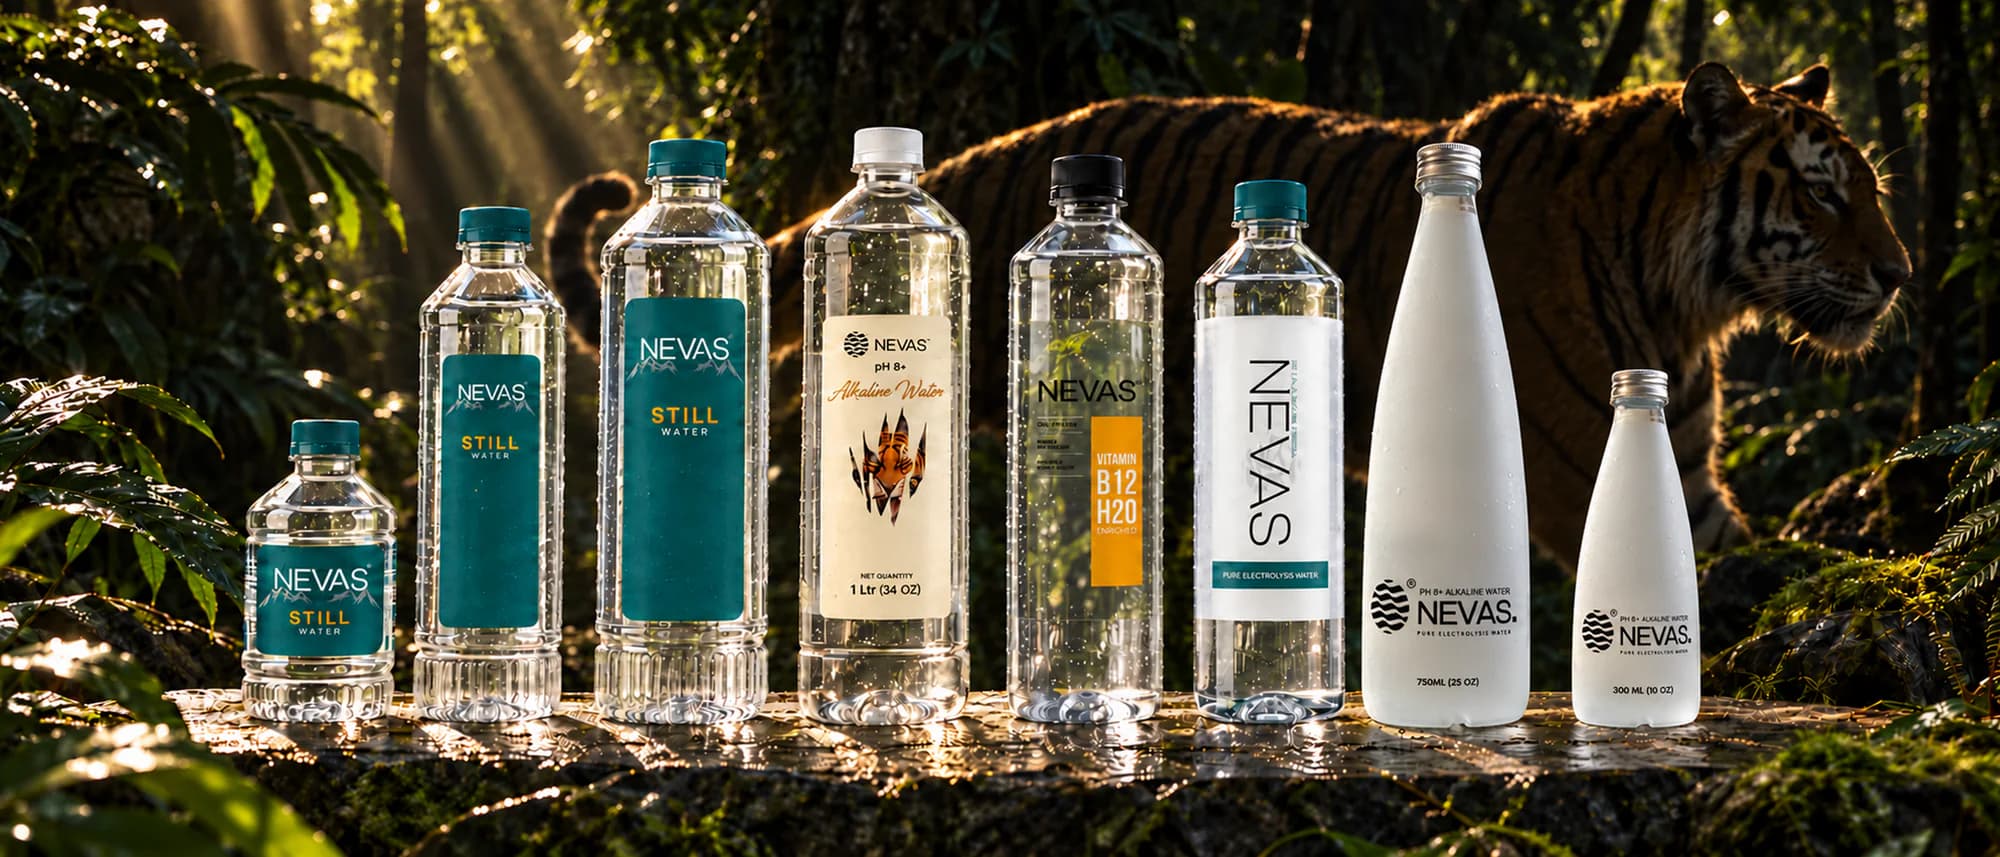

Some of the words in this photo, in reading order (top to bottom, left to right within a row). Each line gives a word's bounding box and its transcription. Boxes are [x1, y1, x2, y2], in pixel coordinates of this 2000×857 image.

[640, 337, 730, 360] NEVAS
[874, 338, 928, 351] NEVAS
[874, 362, 890, 373] pH
[893, 362, 906, 371] 8+
[458, 383, 526, 401] NEVAS
[827, 380, 893, 401] Alkaline
[894, 379, 945, 400] Water
[1037, 379, 1136, 402] NEVAS
[651, 406, 719, 424] STILL
[661, 427, 709, 436] WATER
[461, 435, 519, 451] STILL
[1097, 453, 1137, 465] VITAMIN
[1249, 360, 1291, 546] NEVAS
[1097, 469, 1137, 495] B12
[273, 567, 368, 591] NEVAS
[1222, 571, 1241, 579] PURE
[1242, 572, 1294, 580] ELECTROLYSIS
[1295, 571, 1319, 579] WATER
[850, 584, 856, 595] 1
[859, 584, 876, 595] Ltr
[879, 583, 897, 596] (34
[900, 583, 921, 596] OZ)
[1445, 588, 1484, 596] ALKALINE
[1485, 587, 1511, 595] WATER
[289, 610, 350, 625] STILL
[1417, 600, 1517, 625] NEVAS.
[1620, 625, 1692, 646] NEVAS.
[1416, 678, 1446, 686] 750ML
[1447, 678, 1462, 688] (25
[1463, 678, 1480, 687] OZ)
[1612, 686, 1630, 695] 300
[1631, 686, 1645, 695] ML
[1646, 686, 1658, 696] (10
[1659, 686, 1674, 696] OZ)
